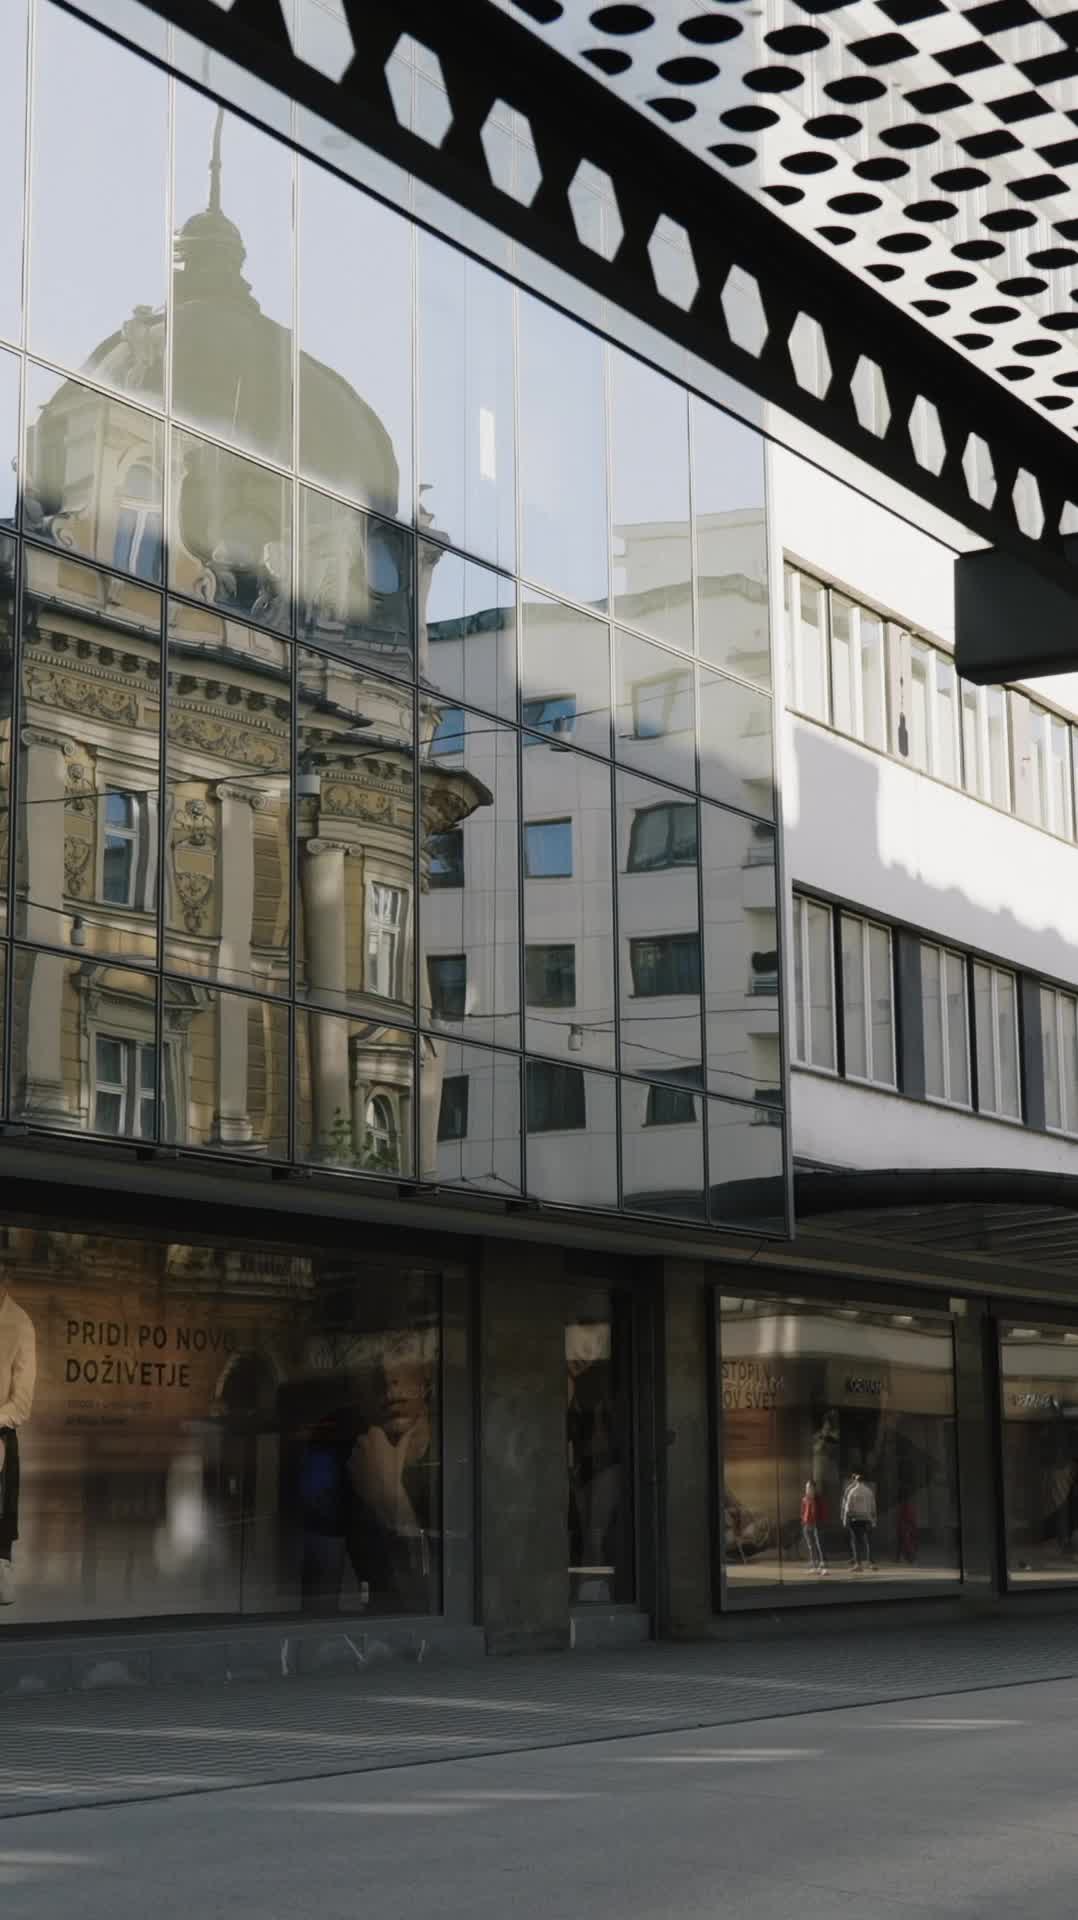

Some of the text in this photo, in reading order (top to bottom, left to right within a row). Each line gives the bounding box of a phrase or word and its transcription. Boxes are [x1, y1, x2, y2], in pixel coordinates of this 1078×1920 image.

[66, 1320, 128, 1346] PRIDI
[139, 1325, 167, 1350] PO
[65, 1354, 192, 1388] DOŽIVETJE
